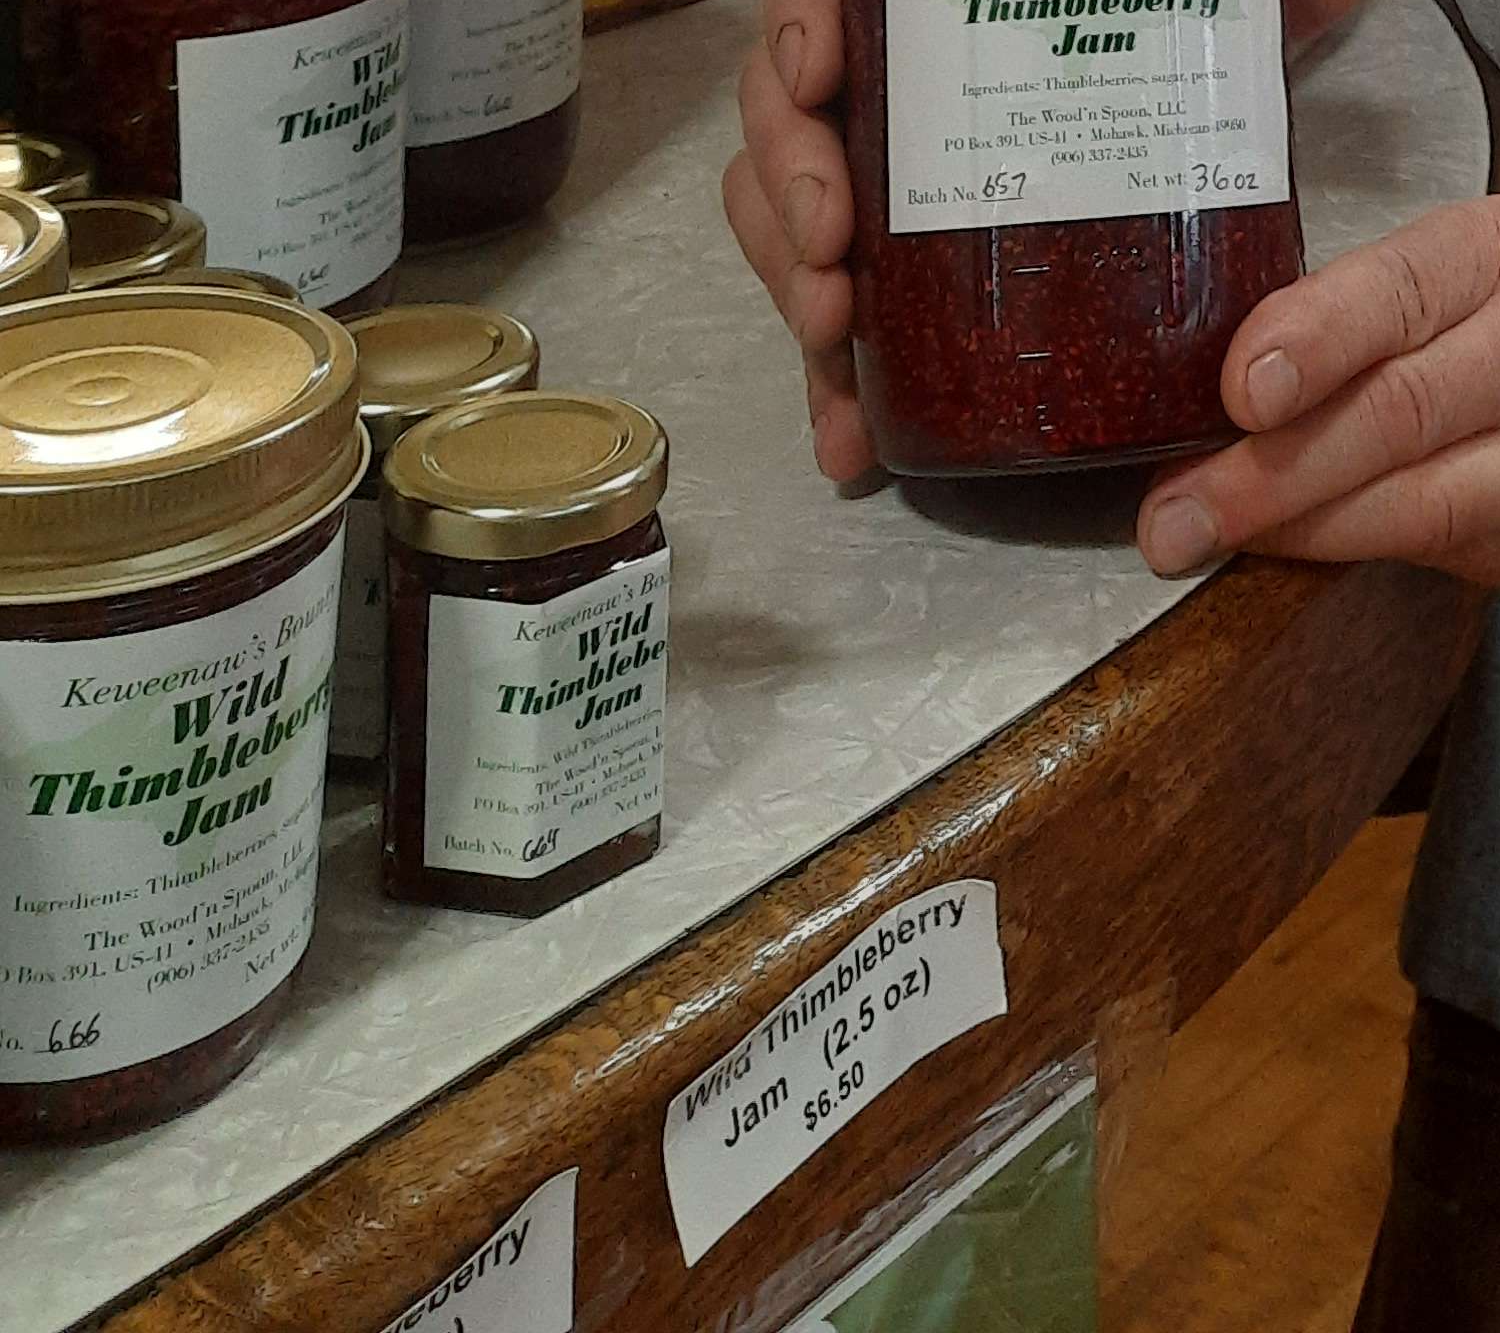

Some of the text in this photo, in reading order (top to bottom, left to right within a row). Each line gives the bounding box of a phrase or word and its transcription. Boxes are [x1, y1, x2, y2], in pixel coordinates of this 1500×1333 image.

[1051, 23, 1137, 57] Jam
[962, 81, 1041, 99] Ingredients:
[1007, 110, 1037, 126] The
[1156, 100, 1187, 116] LLC
[943, 137, 965, 152] PO
[968, 136, 993, 150] Box
[907, 188, 948, 205] Batch
[981, 171, 1027, 199] 657
[1191, 163, 1229, 193] 36
[1234, 172, 1260, 191] oz
[512, 583, 635, 642] Keweenaw's
[577, 601, 654, 662] Wild
[60, 633, 267, 708] Keweenaw's
[496, 639, 667, 716] Thimblebe
[172, 654, 291, 745] Wild
[575, 683, 643, 730] Jam
[163, 776, 273, 847] Jam
[444, 834, 486, 855] Batch
[83, 931, 130, 951] The
[18, 966, 56, 984] Box
[684, 892, 968, 1122] Wild Thimbleberry
[48, 1013, 101, 1054] 666
[723, 956, 932, 1149] Jam (2.5 oz)
[803, 1060, 865, 1133] $6.50
